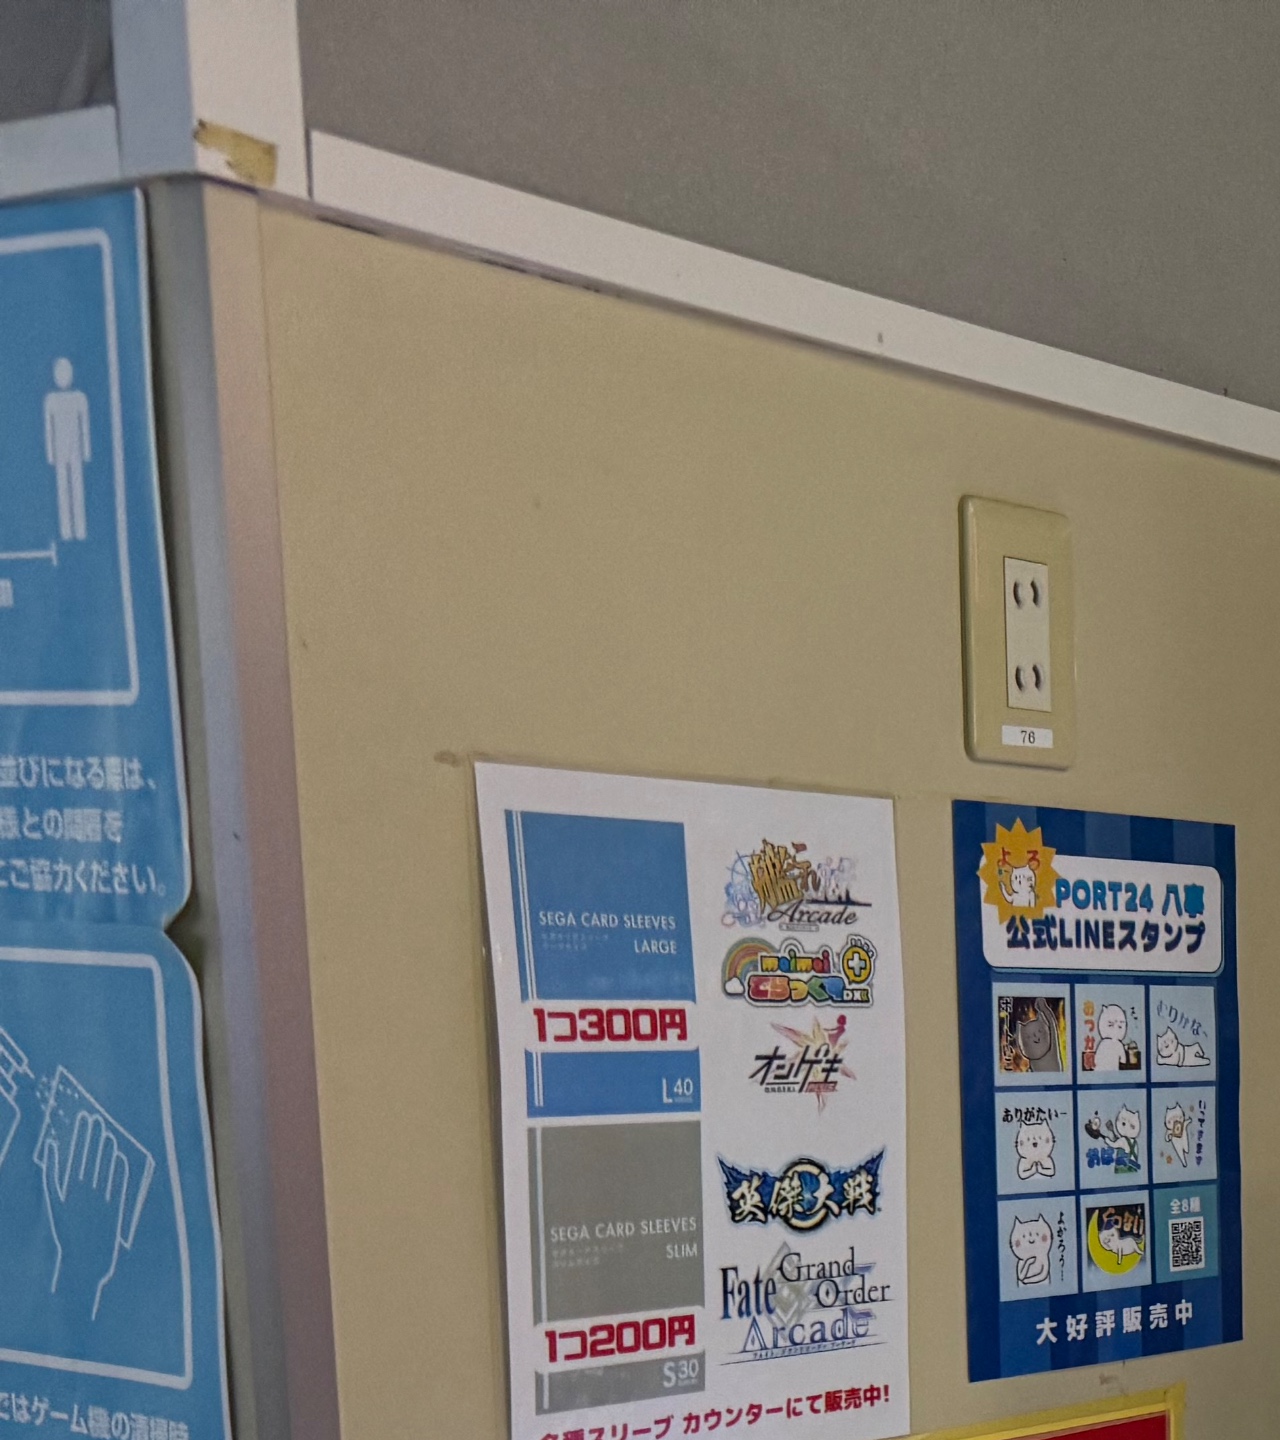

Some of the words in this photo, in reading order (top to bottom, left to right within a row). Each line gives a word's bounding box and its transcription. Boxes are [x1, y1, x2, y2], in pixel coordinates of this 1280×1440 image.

[1020, 730, 1036, 745] 76
[767, 899, 858, 926] Arcade
[1055, 877, 1154, 913] PORT24
[1161, 882, 1205, 918] 八事
[538, 910, 577, 928] SEGA
[581, 911, 619, 929] CARD
[623, 914, 676, 930] SLEEVES
[1005, 914, 1207, 954] 公式LINEスタンプ
[633, 939, 678, 955] LARGE
[532, 1007, 688, 1043] 1コ300円
[731, 1167, 877, 1222] 英傑大戦
[550, 1224, 590, 1242] SEGA
[595, 1221, 636, 1239] CARD
[640, 1216, 697, 1236] SLEEVES
[665, 1243, 698, 1259] SLIM
[719, 1265, 777, 1319] Fate
[777, 1247, 858, 1283] Grand
[814, 1274, 891, 1309] Order
[544, 1313, 696, 1363] 1コ200円
[742, 1306, 870, 1351] Arcade
[1035, 1299, 1194, 1346] 大好評販売中
